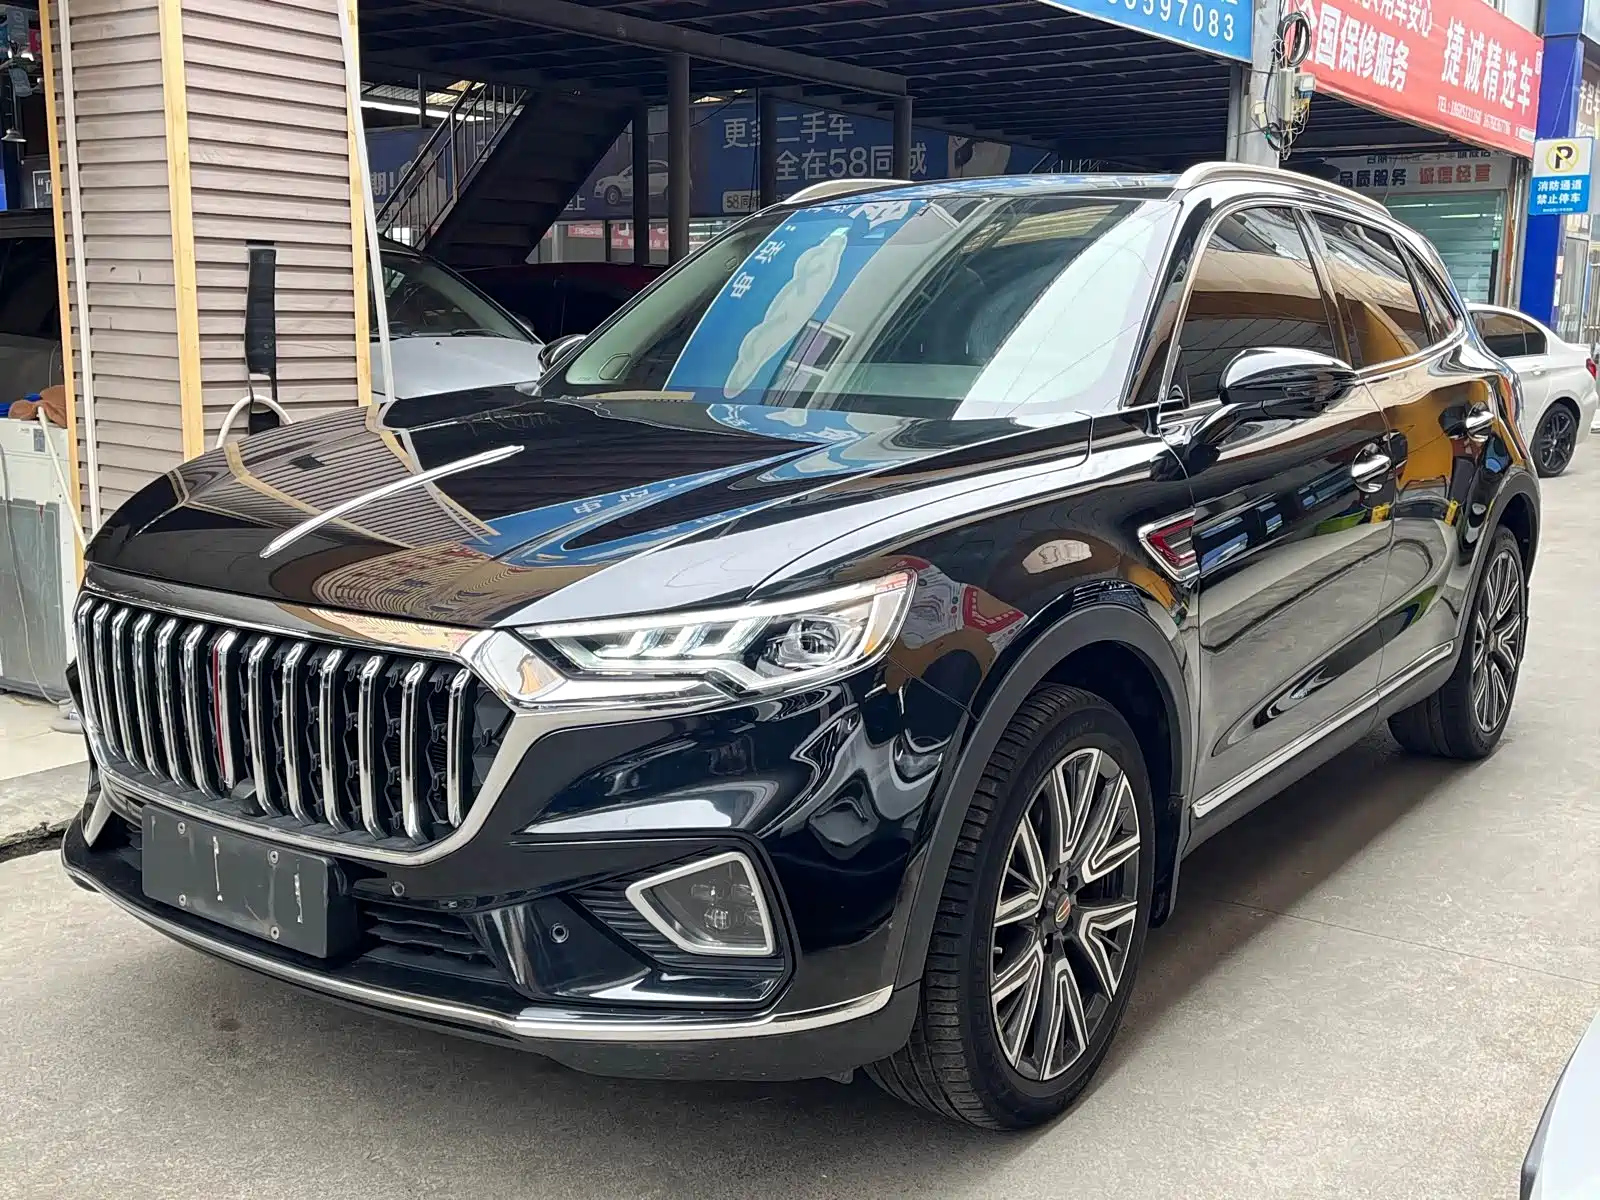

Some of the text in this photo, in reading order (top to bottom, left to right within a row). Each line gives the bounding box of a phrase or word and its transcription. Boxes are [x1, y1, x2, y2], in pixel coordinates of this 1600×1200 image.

[1108, 0, 1234, 41] 597083
[1441, 16, 1533, 115] 捷诚精选车
[1536, 193, 1581, 205] 禁止停车
[1537, 179, 1582, 192] 消防通道
